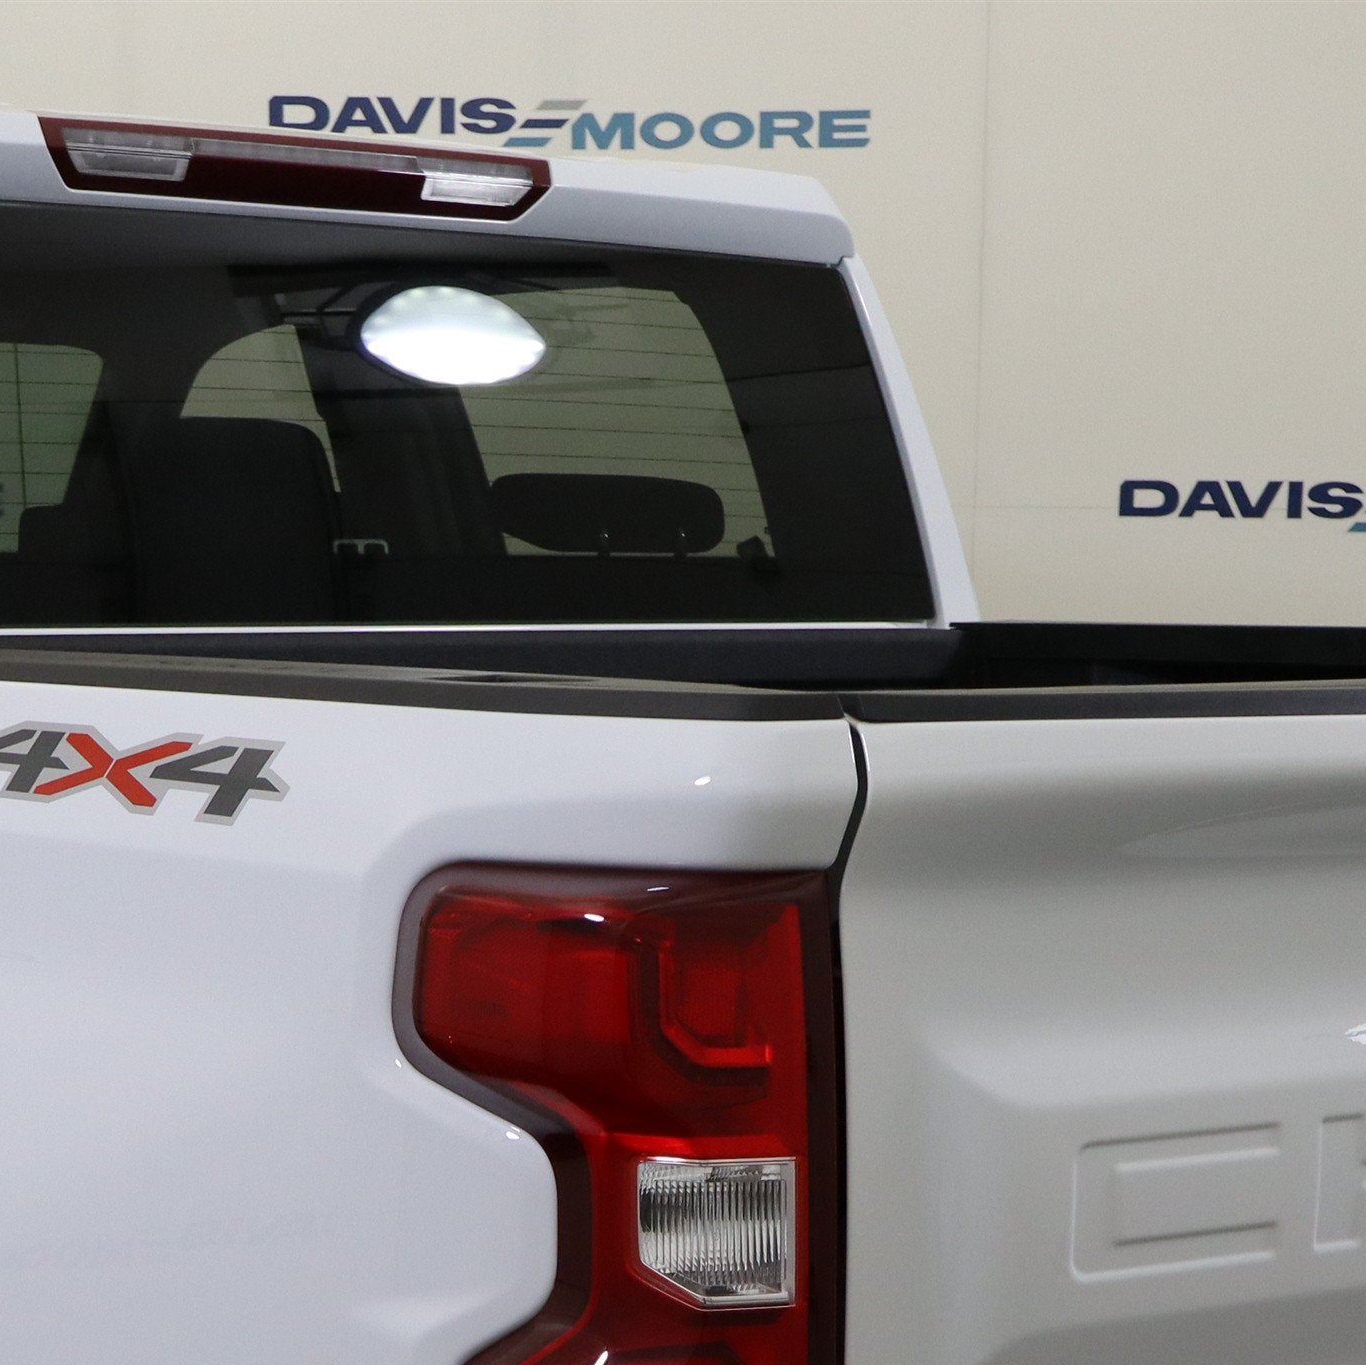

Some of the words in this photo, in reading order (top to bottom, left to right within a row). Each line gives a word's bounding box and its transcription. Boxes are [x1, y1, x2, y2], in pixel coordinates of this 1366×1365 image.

[268, 95, 520, 135] DAVIS
[572, 109, 871, 150] MOORE
[1118, 479, 1365, 520] DAVIS
